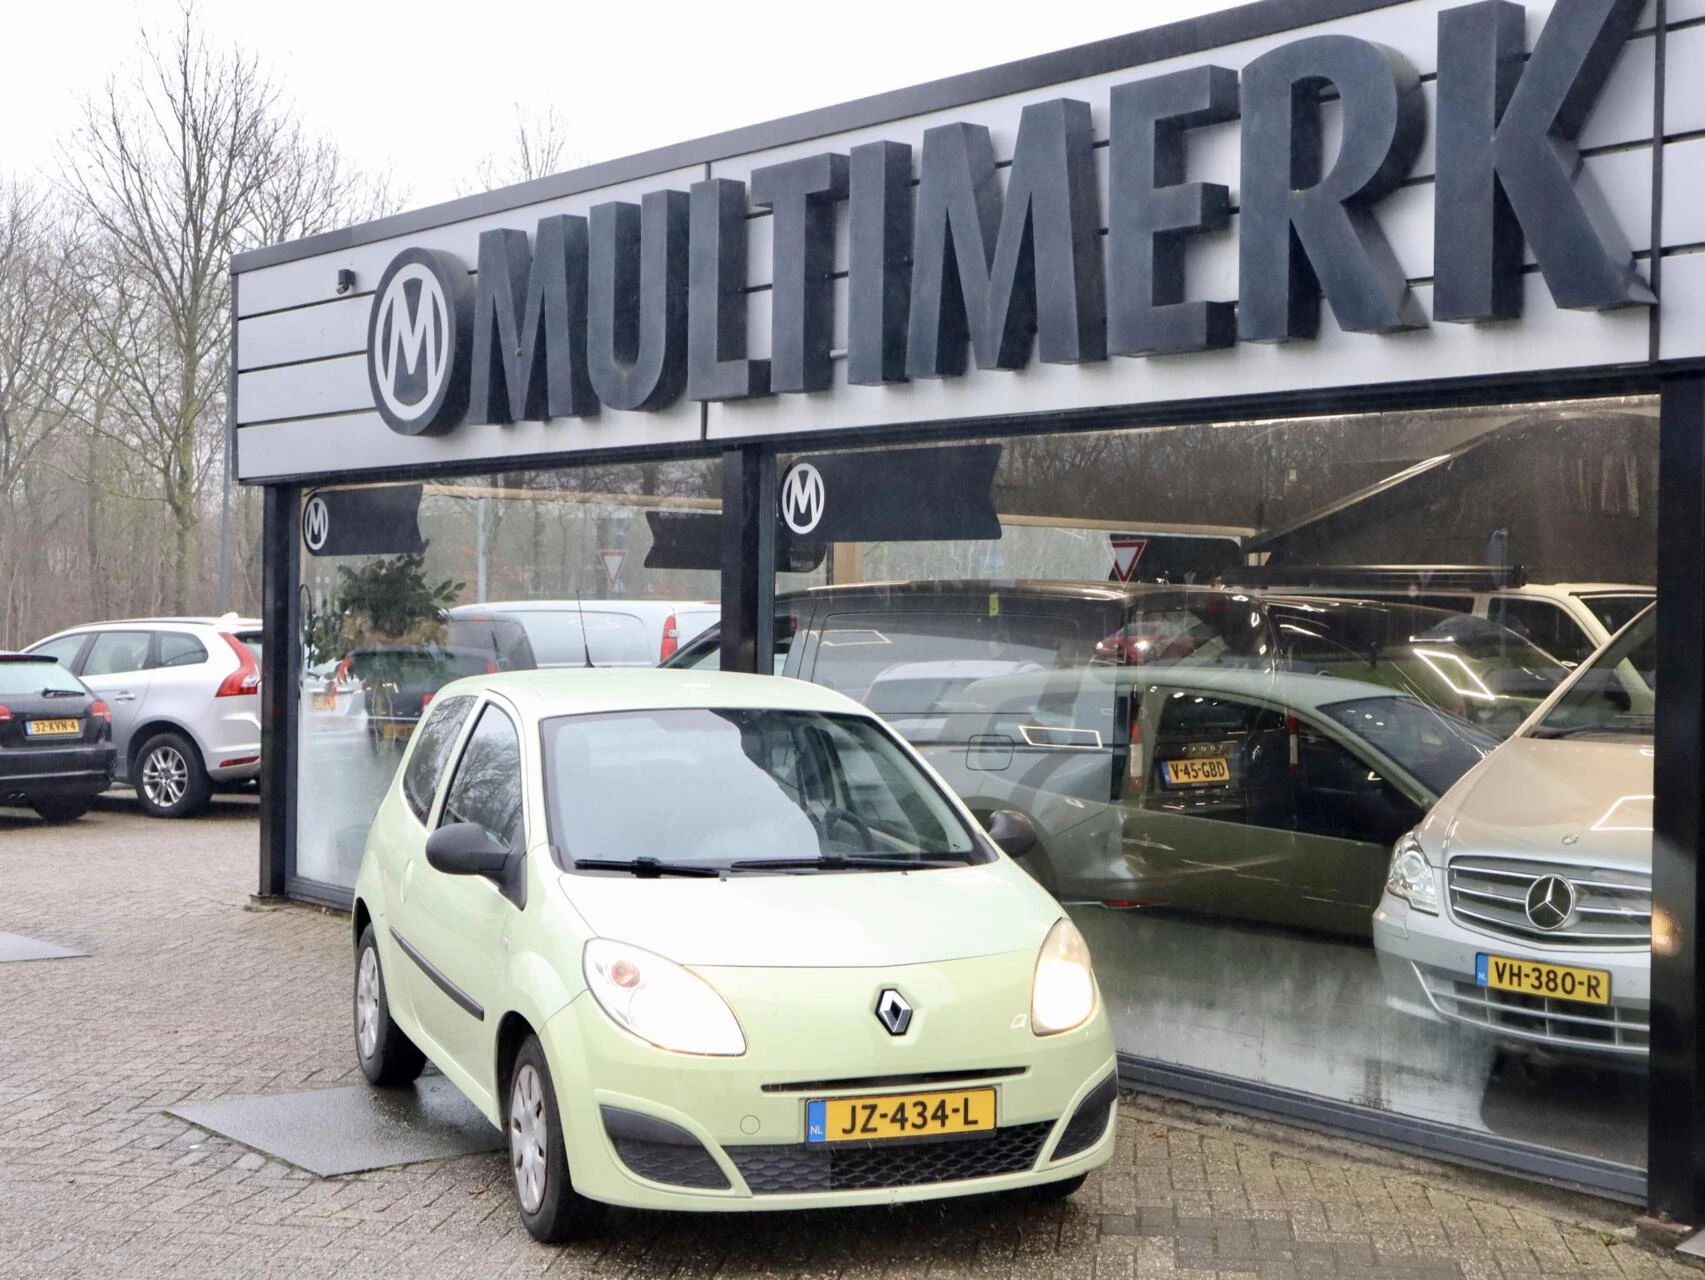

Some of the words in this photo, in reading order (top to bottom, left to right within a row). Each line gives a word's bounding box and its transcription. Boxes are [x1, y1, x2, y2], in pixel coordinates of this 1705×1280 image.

[374, 262, 450, 421] M
[468, 0, 1658, 426] MULTIMERK
[782, 463, 825, 535] M
[1170, 761, 1226, 781] V-45-GBD
[1494, 961, 1601, 999] VH-380-R
[810, 1126, 824, 1136] NL
[841, 1097, 979, 1135] JZ-434-L
